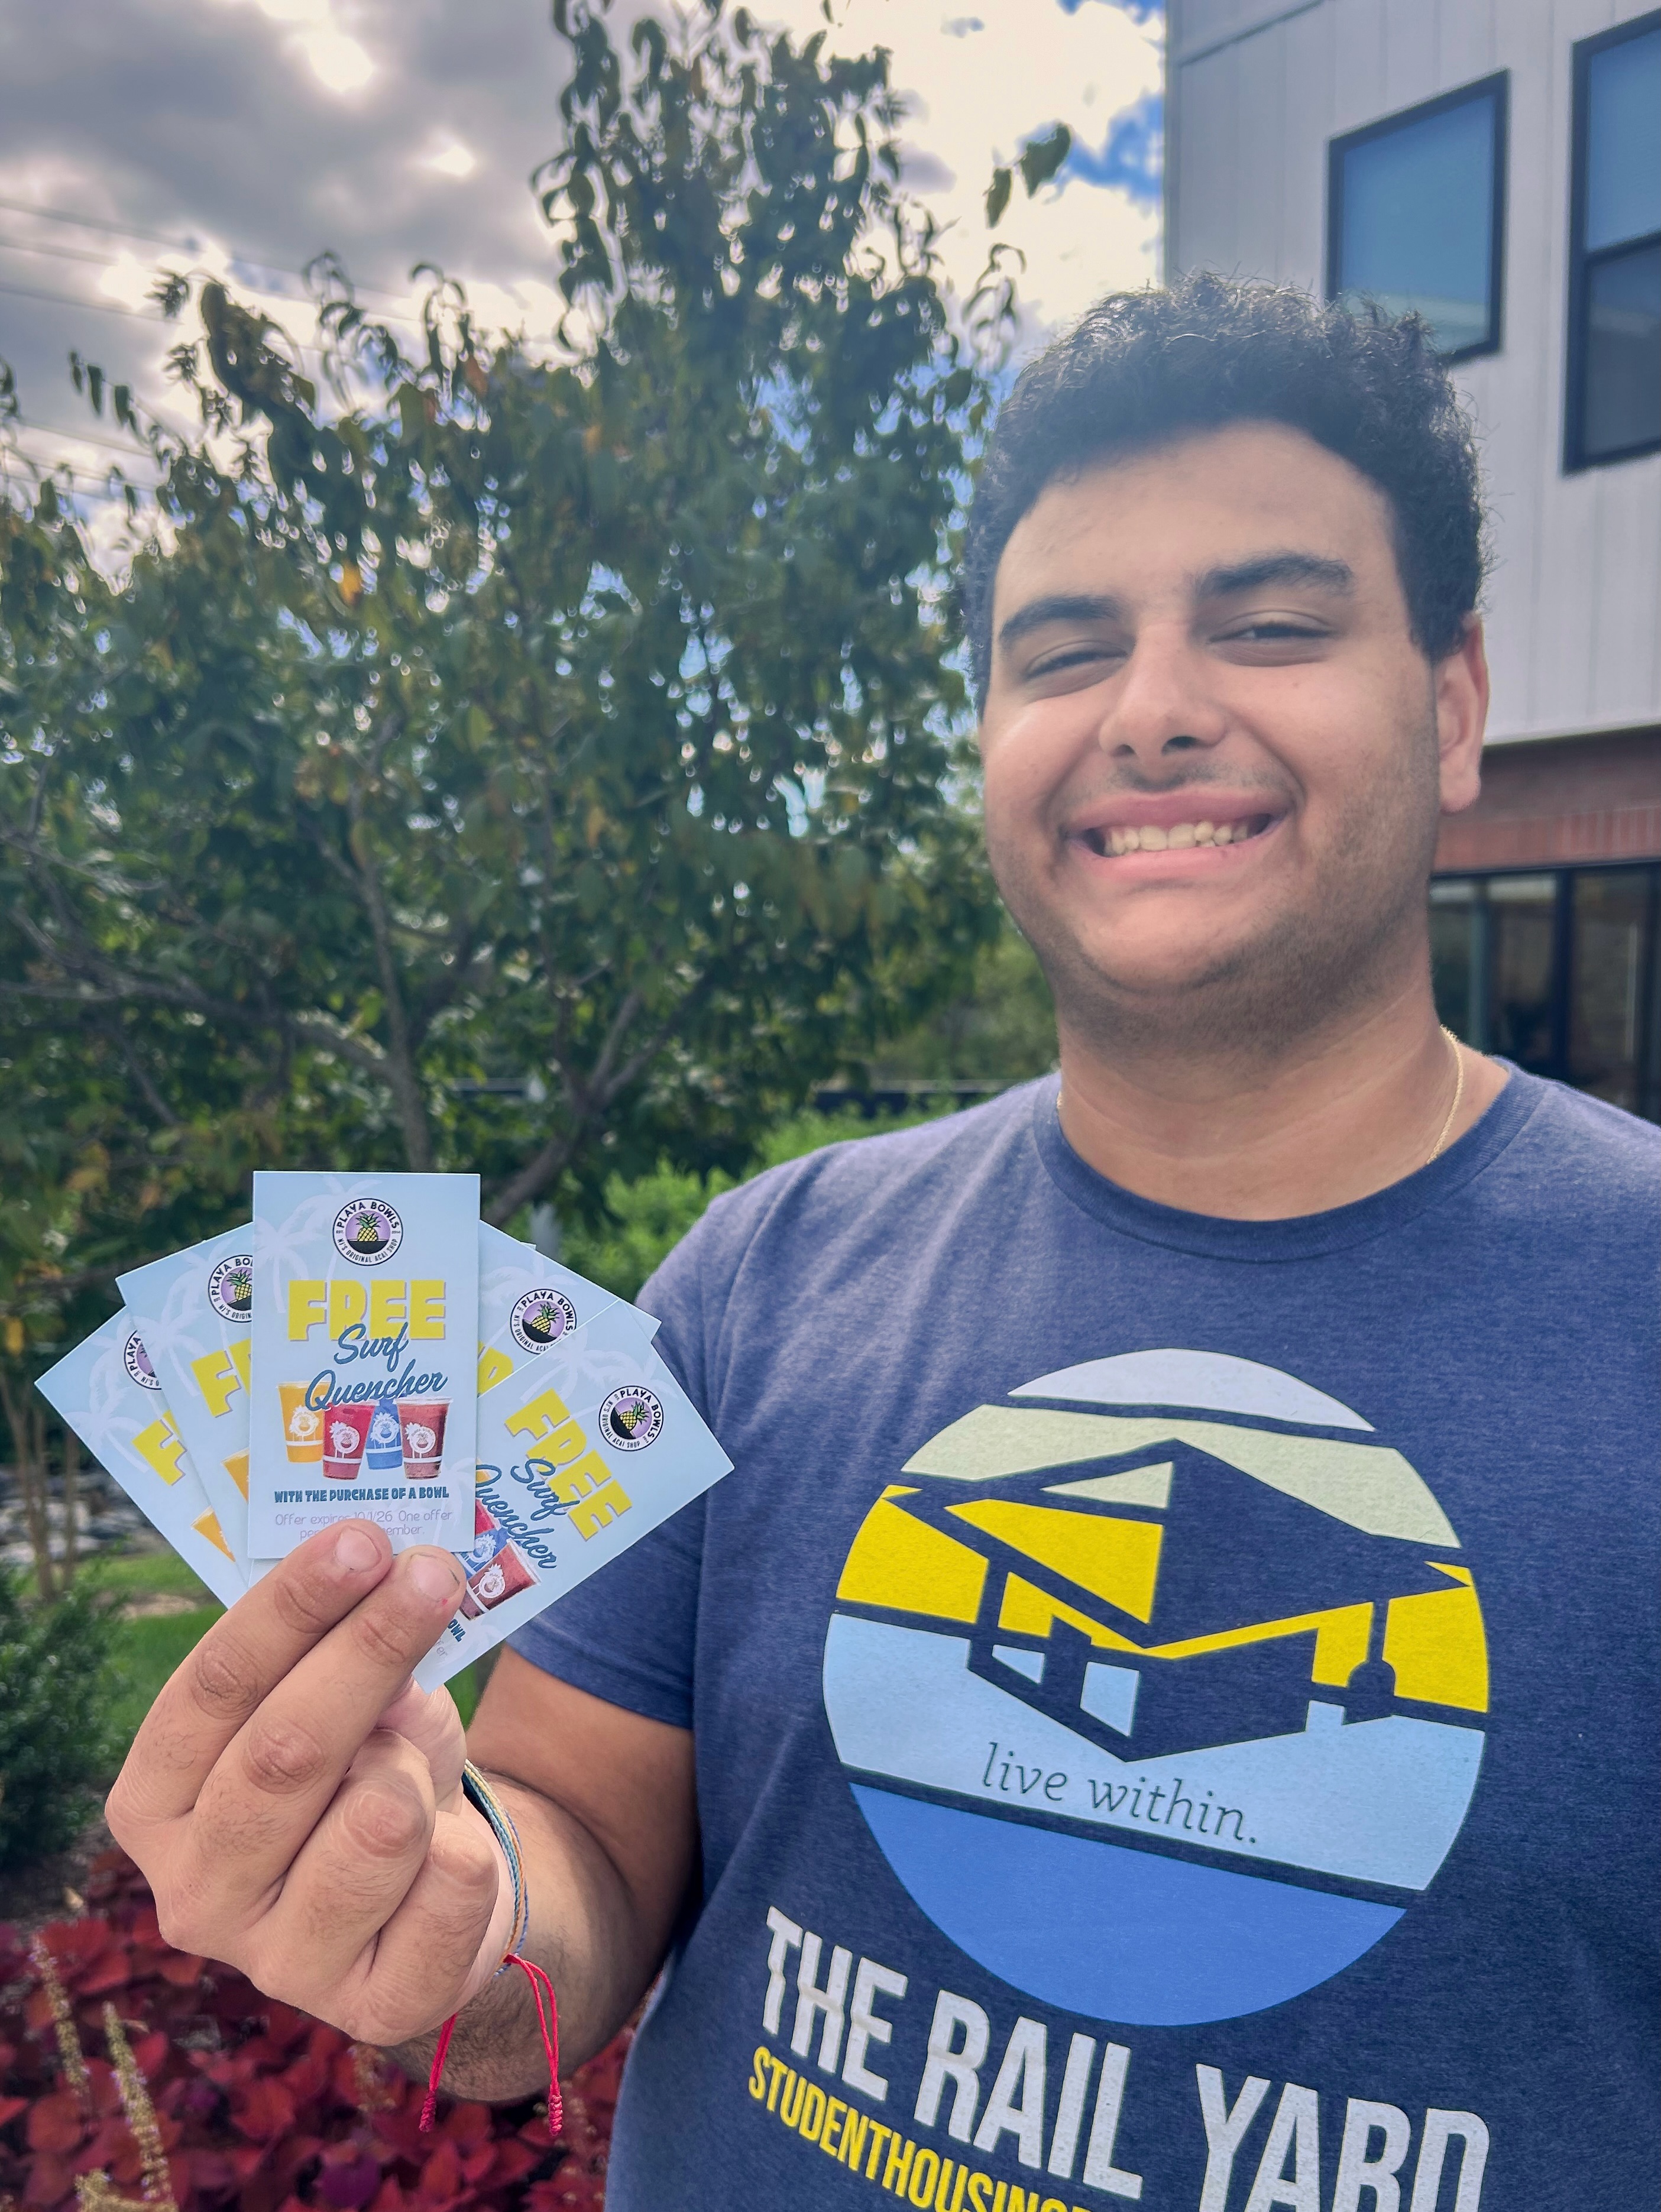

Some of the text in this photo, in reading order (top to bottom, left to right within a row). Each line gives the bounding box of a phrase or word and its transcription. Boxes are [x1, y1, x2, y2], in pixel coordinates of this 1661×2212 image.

[336, 1201, 400, 1229] PLAYA BOWLS
[346, 1249, 373, 1263] ORIGINAL
[211, 1264, 232, 1296] PLAYA
[287, 1280, 446, 1342] FREE
[520, 1290, 574, 1332] PLAYA BOWLS
[127, 1337, 141, 1371] PLAYA
[334, 1322, 409, 1372] Surf
[305, 1359, 448, 1411] Quencher
[602, 1414, 613, 1439] ORIGINAL
[620, 1388, 661, 1438] PLAYA BOWLS
[504, 1387, 633, 1542] FREE
[274, 1486, 449, 1503] WITH THE PURCHASE OF A BOWL
[510, 1459, 580, 1521] Surf
[275, 1513, 307, 1526] Offer
[399, 1510, 420, 1522] One
[423, 1509, 452, 1521] offer
[382, 1524, 425, 1536] ember.
[982, 1741, 1257, 1844] live within.
[762, 1905, 1491, 2212] THE RAIL YARD
